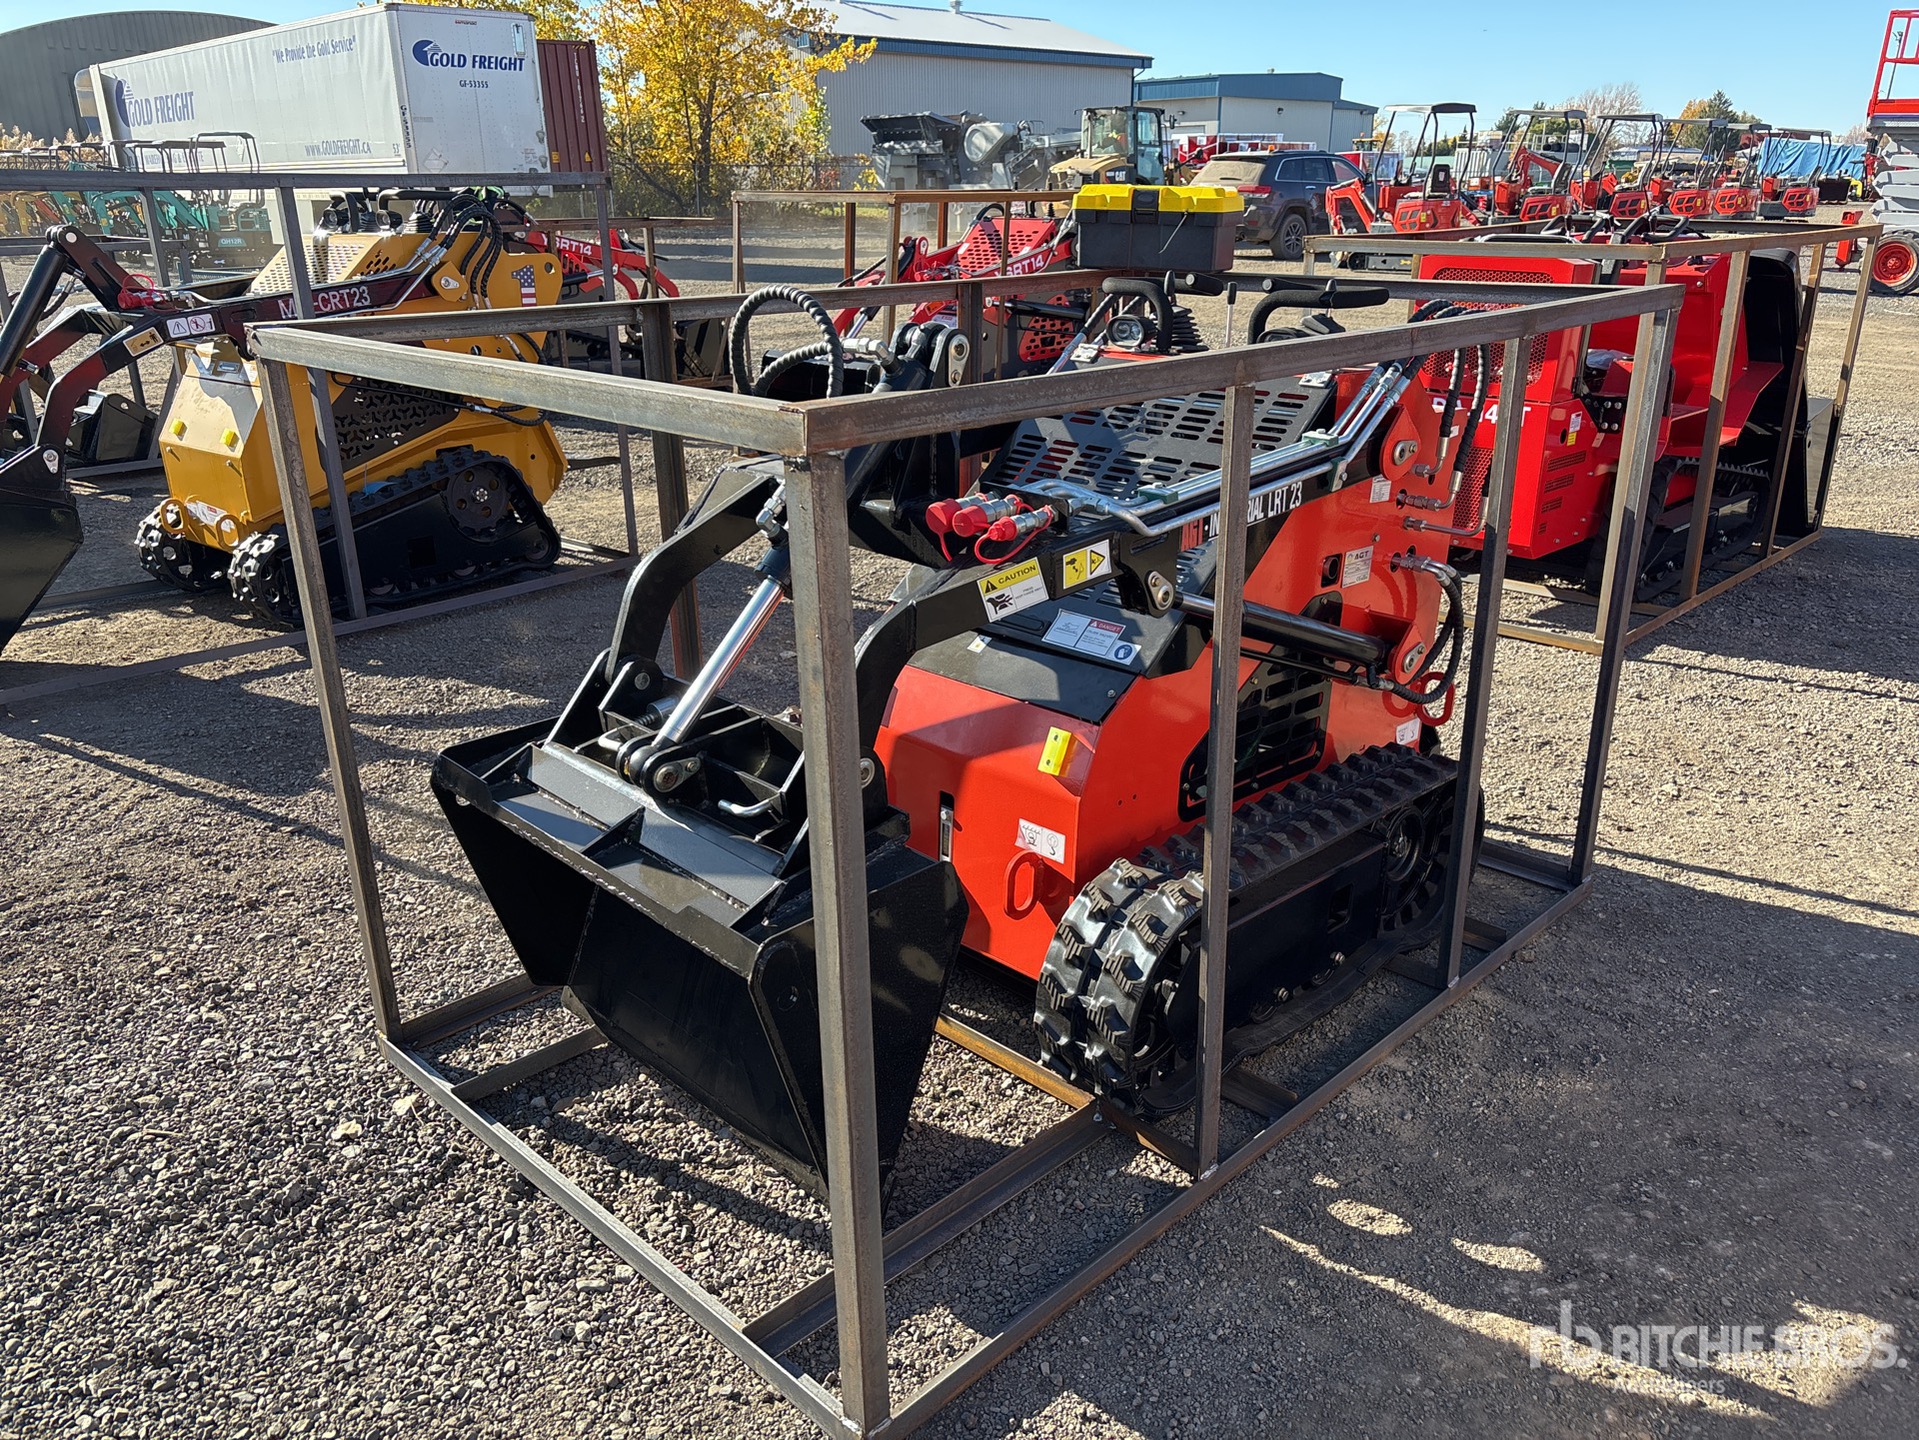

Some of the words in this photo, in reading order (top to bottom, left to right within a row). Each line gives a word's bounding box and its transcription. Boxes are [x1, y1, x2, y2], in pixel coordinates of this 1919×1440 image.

[285, 45, 305, 61] Provide
[306, 43, 316, 59] the
[317, 39, 330, 57] Gold
[430, 52, 467, 68] GOLD
[472, 55, 525, 71] FREIGHT
[459, 79, 489, 89] GF-53355
[127, 98, 153, 127] GOLD
[155, 91, 195, 124] FREIGHT
[1267, 485, 1289, 518] LRT
[1289, 481, 1303, 510] 23
[1354, 550, 1370, 561] AGT
[998, 565, 1036, 585] CAUTION
